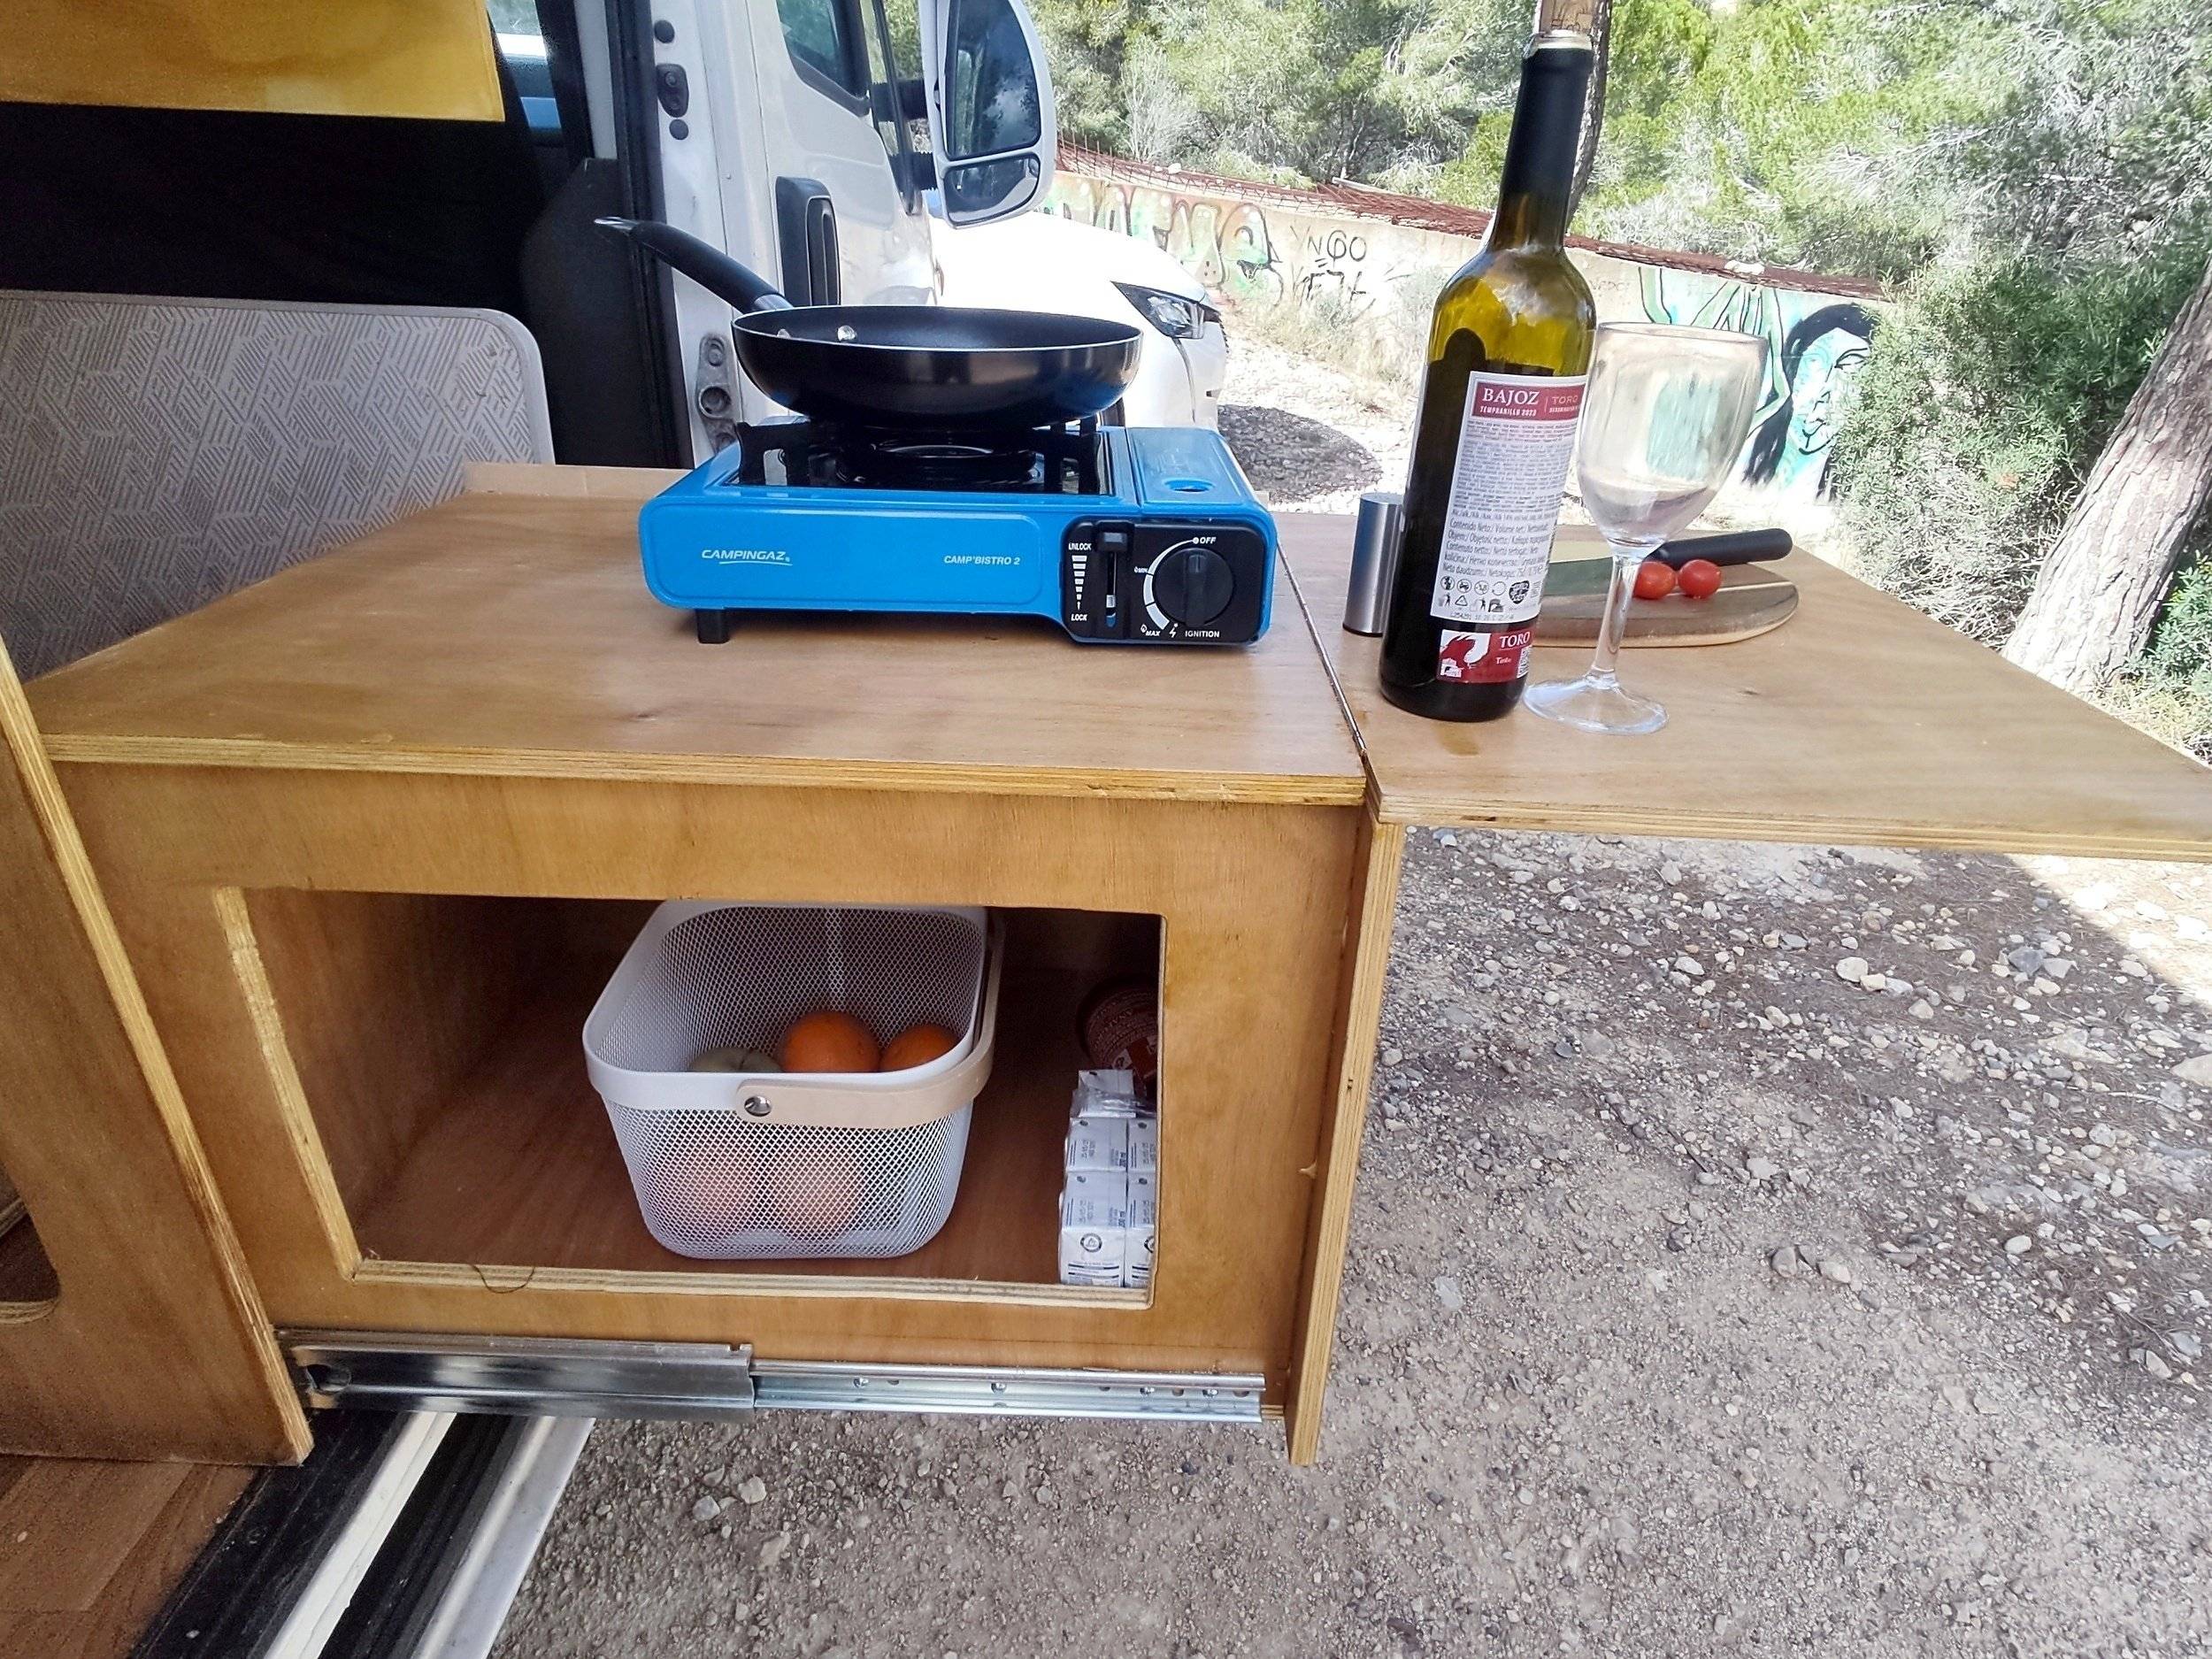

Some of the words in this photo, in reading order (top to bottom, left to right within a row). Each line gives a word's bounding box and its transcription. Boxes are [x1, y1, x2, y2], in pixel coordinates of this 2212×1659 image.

[1482, 388, 1540, 406] BAJOZ
[1068, 542, 1092, 551] UNLOCK
[701, 549, 787, 561] CAMPINGAZ
[944, 555, 1012, 565] CAMP'BISTRO
[1013, 557, 1021, 565] 2
[1500, 631, 1531, 649] TORO
